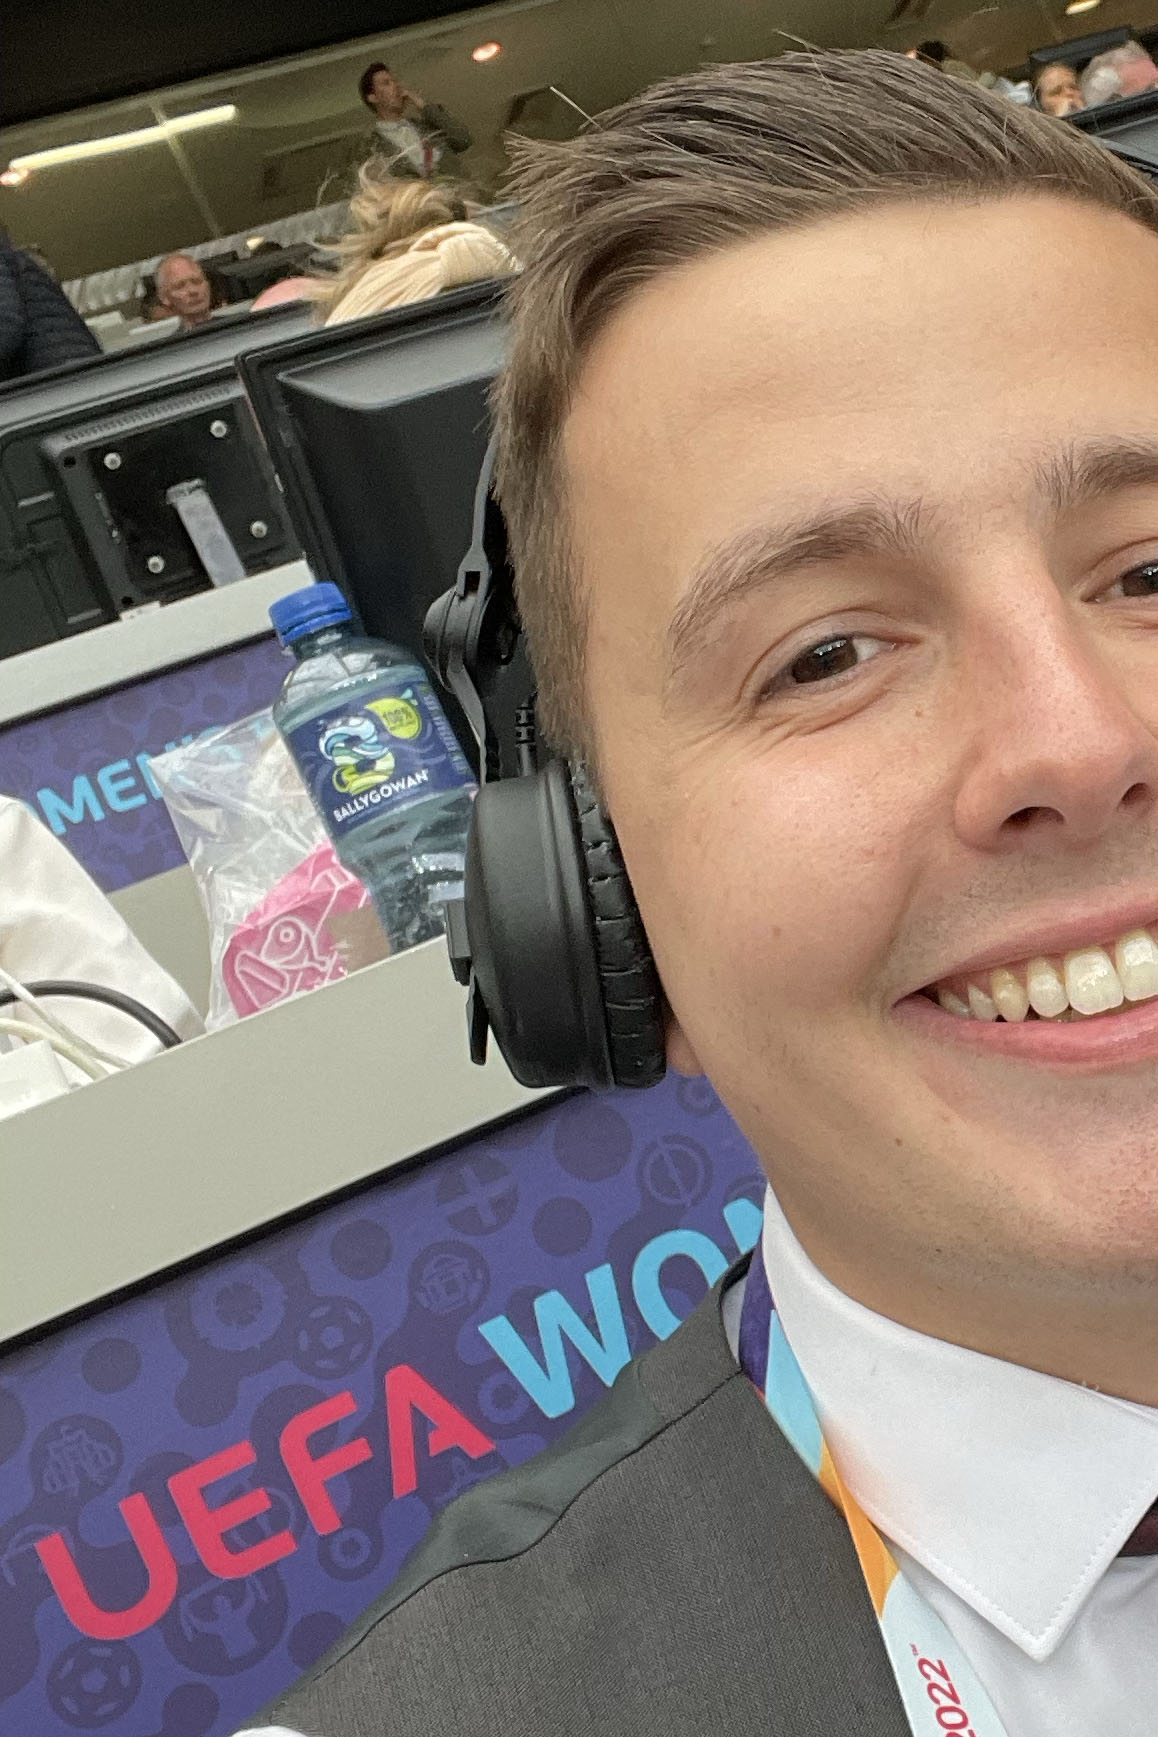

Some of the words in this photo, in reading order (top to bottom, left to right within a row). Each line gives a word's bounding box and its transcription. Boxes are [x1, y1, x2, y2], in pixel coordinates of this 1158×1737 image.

[333, 768, 429, 823] BALLYGOWAN
[34, 1364, 497, 1640] UEFA
[478, 1197, 764, 1419] WO
